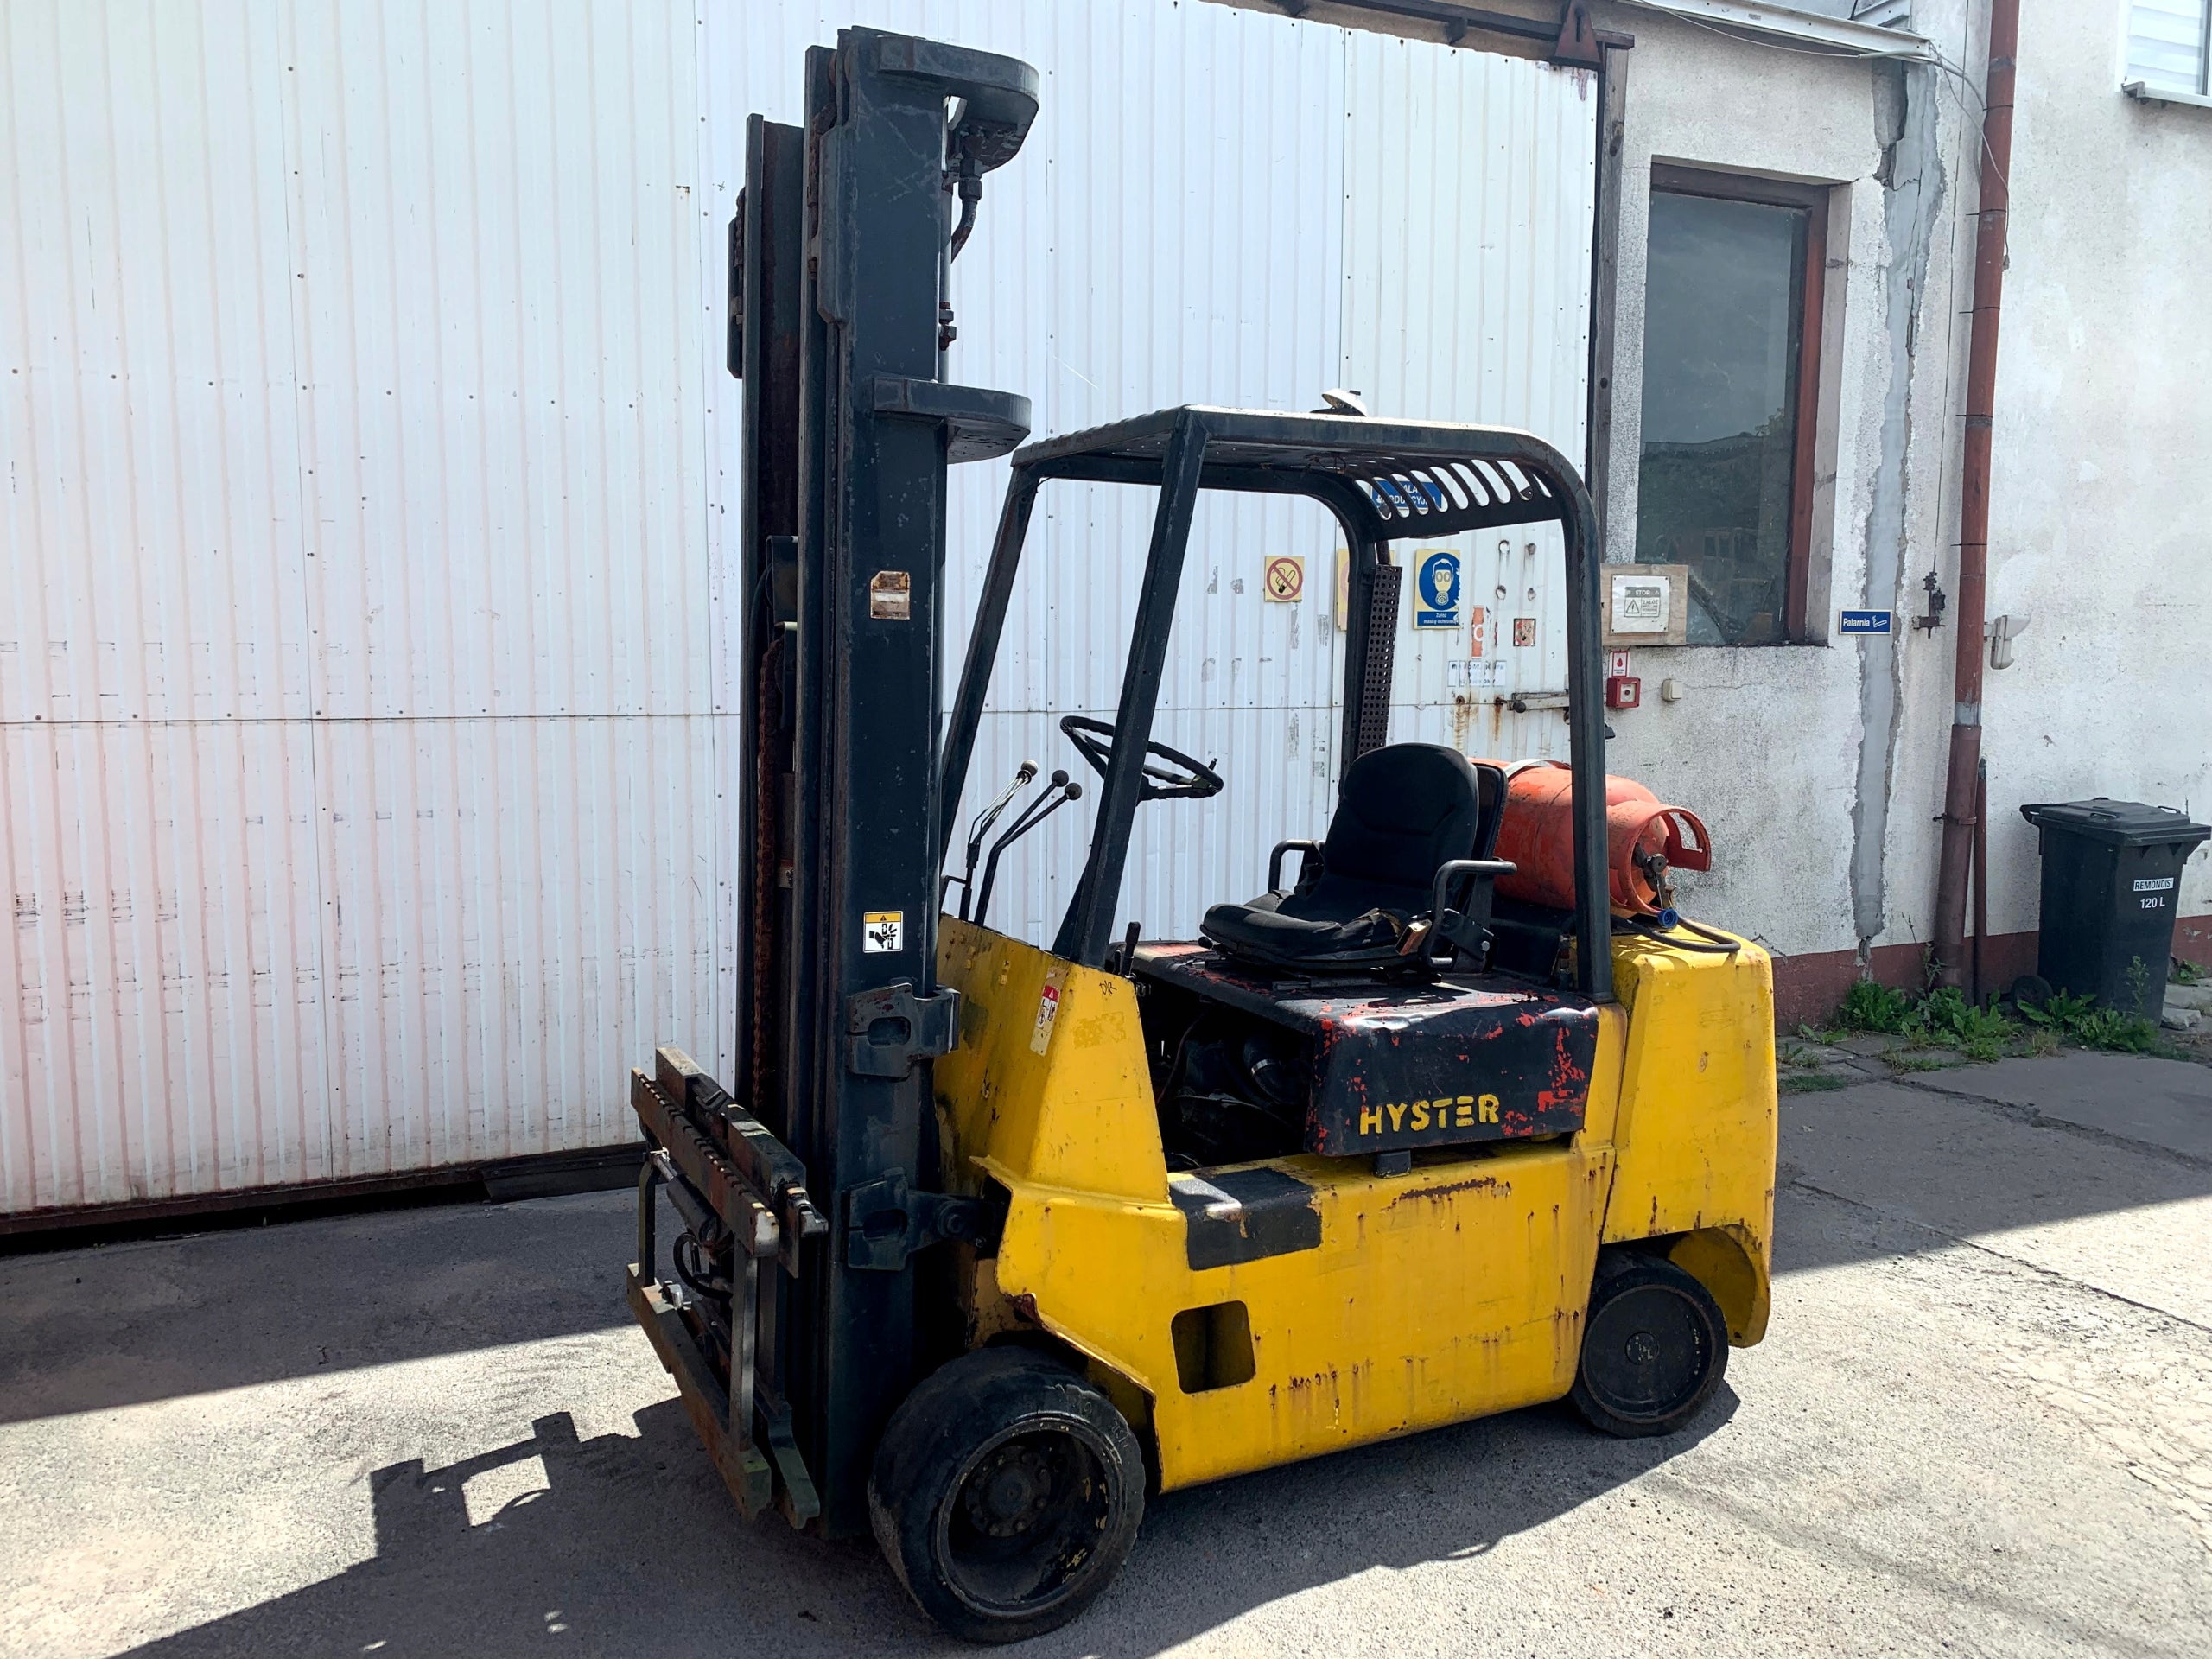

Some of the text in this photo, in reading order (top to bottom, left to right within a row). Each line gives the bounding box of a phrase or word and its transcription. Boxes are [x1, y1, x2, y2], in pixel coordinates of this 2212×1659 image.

[1843, 618, 1871, 627] Palarnia
[2135, 879, 2171, 890] REMONDIS
[2140, 897, 2166, 909] 120 L
[1359, 1094, 1500, 1135] HYSTER
